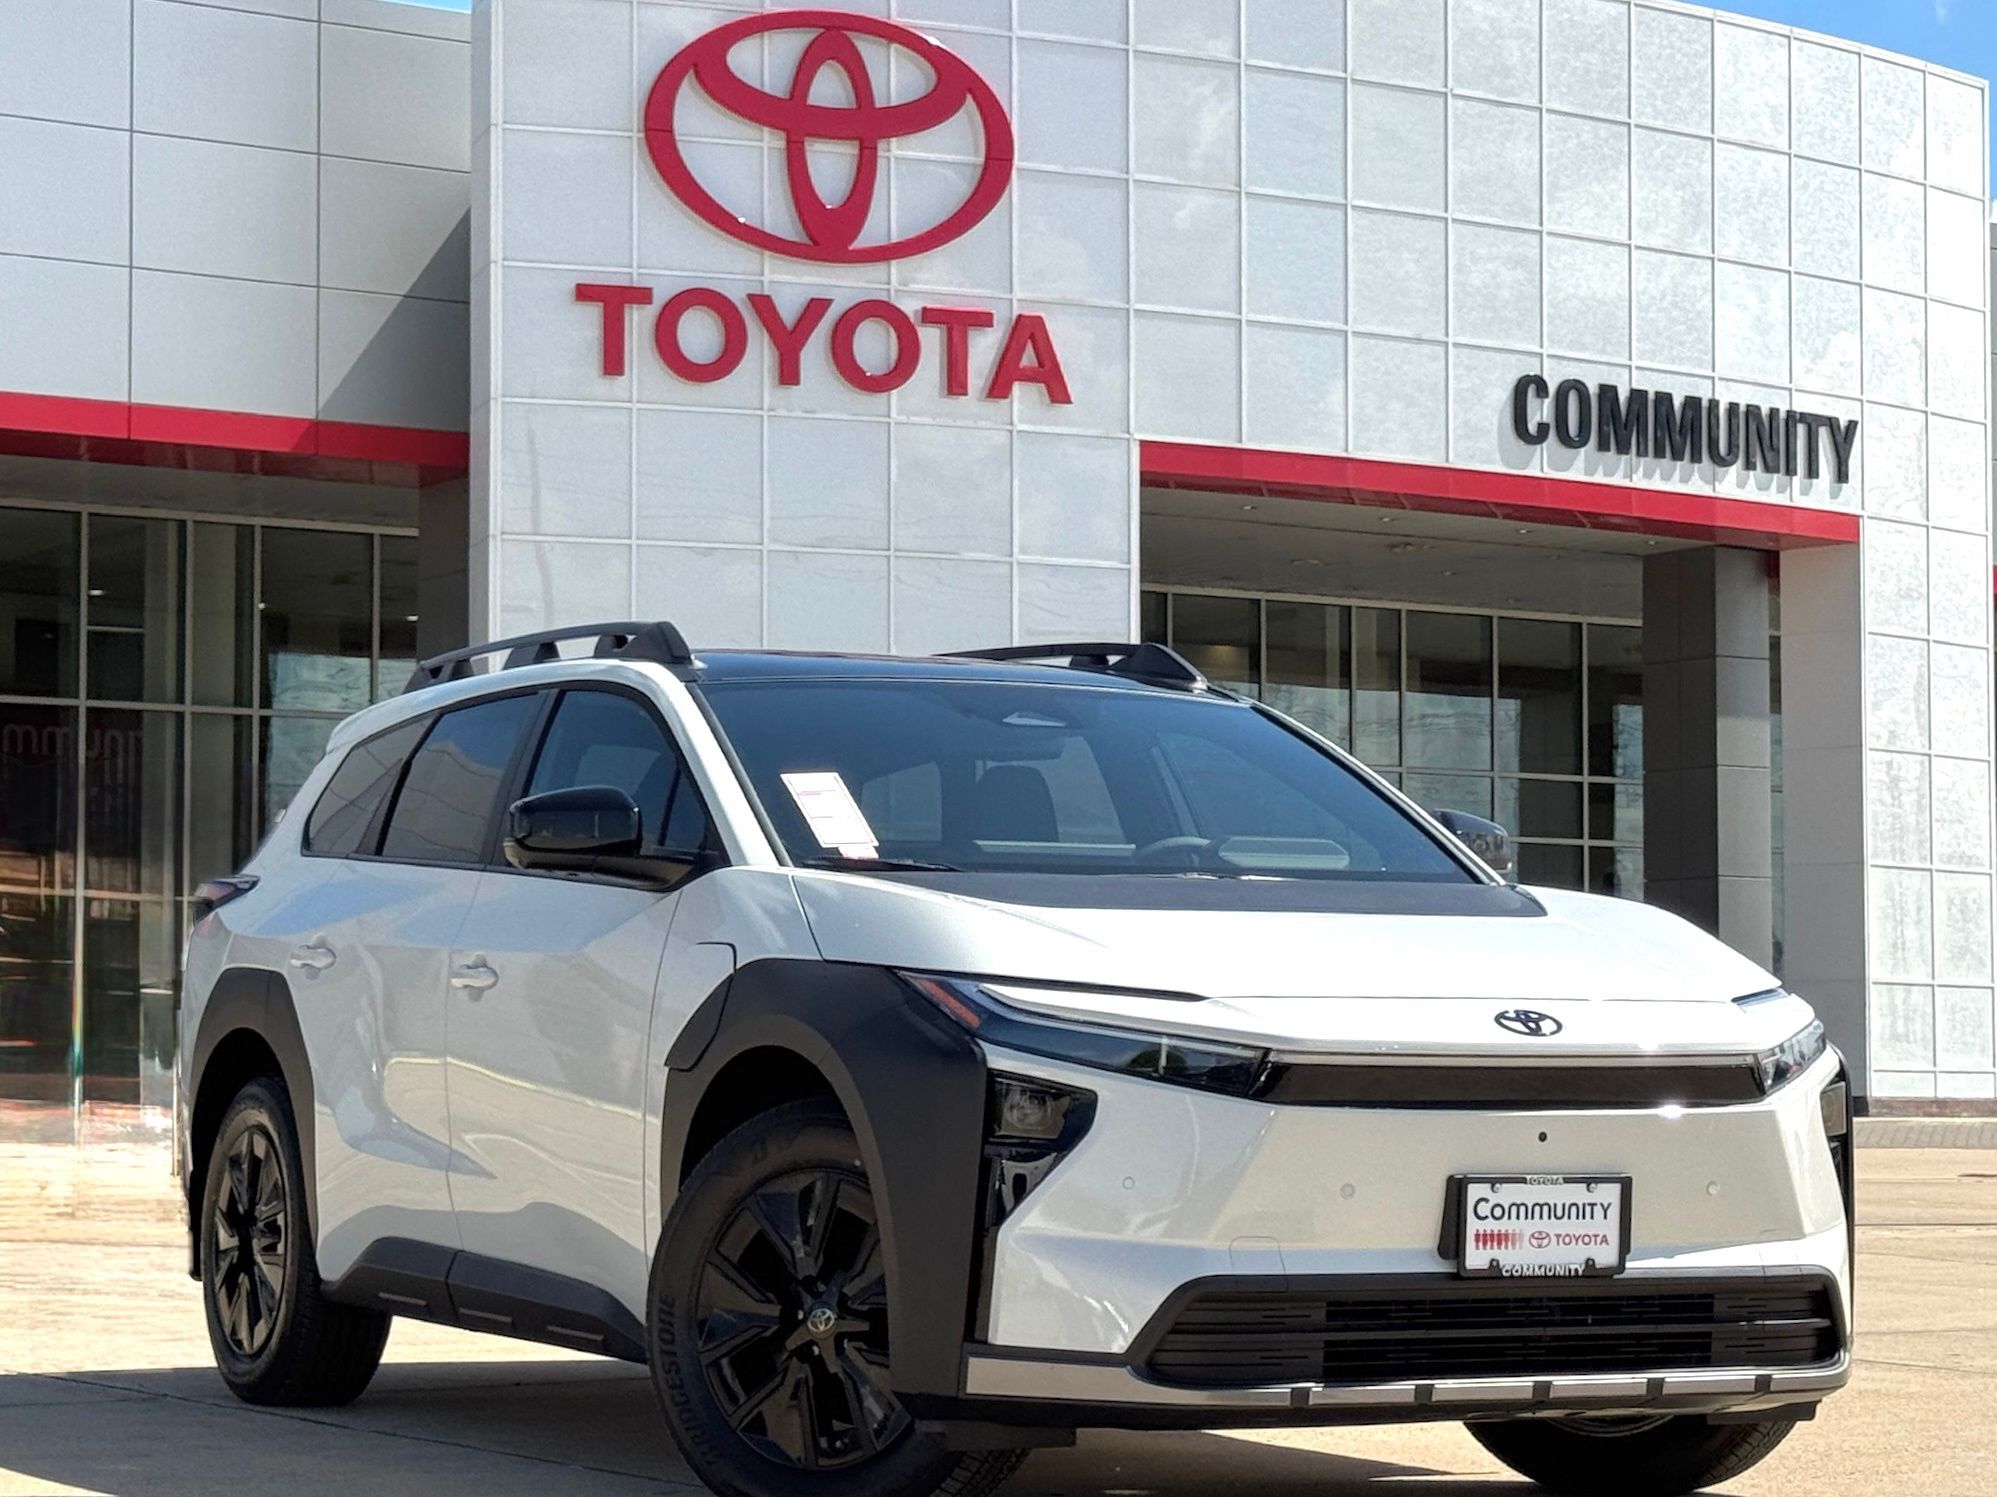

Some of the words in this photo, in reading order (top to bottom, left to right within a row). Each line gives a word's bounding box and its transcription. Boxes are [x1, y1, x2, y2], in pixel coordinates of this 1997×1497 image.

[574, 282, 1074, 405] TOYOTA
[1513, 373, 1860, 485] COMMUNITY
[1526, 1175, 1565, 1186] TOYOTA
[1554, 1232, 1610, 1247] TOYOTA
[1501, 1262, 1585, 1278] COMMUNITY
